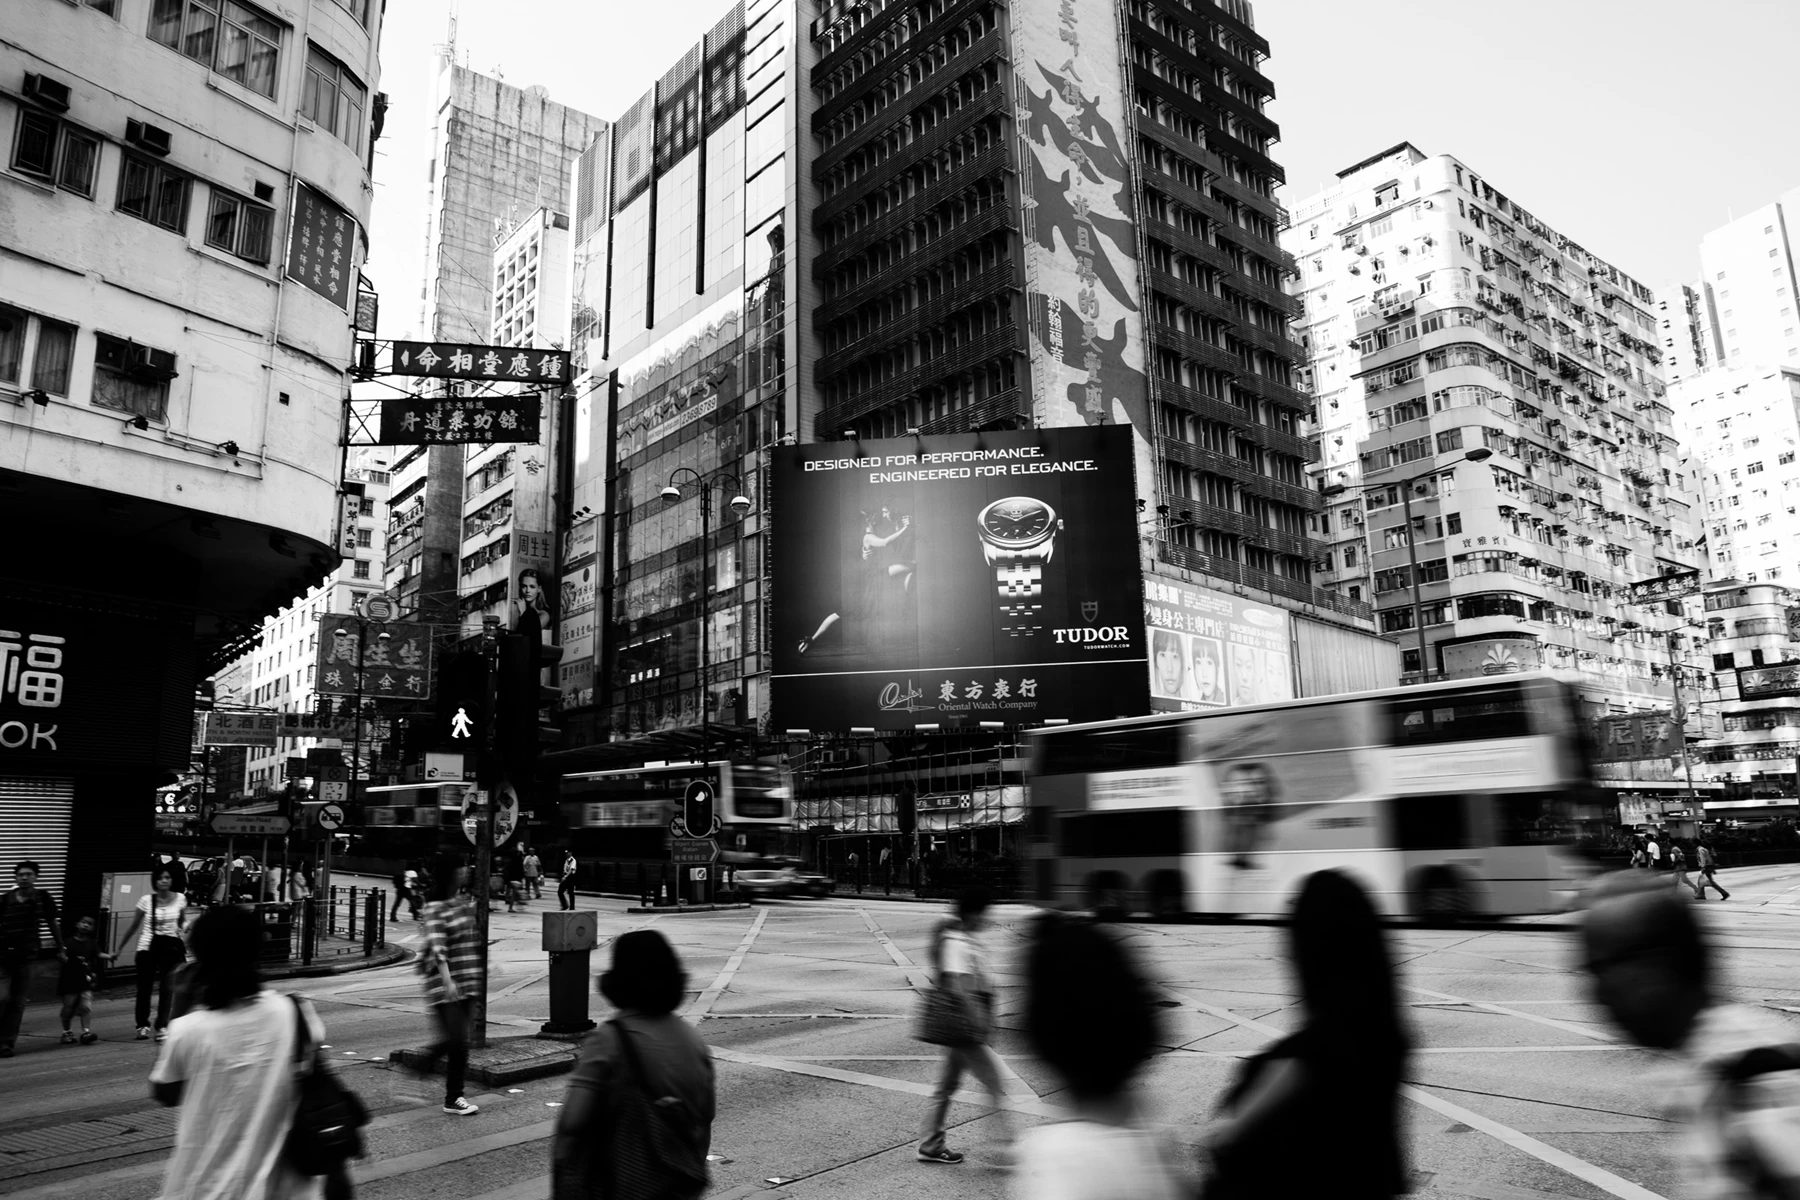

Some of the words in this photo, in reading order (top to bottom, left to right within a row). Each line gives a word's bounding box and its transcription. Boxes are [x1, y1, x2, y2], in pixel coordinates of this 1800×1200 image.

[804, 457, 881, 471] DESIGNED
[885, 454, 917, 466] FOR
[921, 447, 1044, 464] PERFORMANCE.
[869, 467, 971, 483] ENGINEERED
[975, 465, 1007, 477] FOR
[1011, 460, 1098, 474] ELEGANCE.
[517, 534, 550, 559] 周生生
[1053, 626, 1129, 643] TUDOR
[326, 634, 423, 670] 周生生
[0, 630, 66, 708] 福
[938, 678, 1038, 702] 東方表行
[938, 702, 971, 711] Oriental
[973, 701, 998, 710] Watch
[998, 700, 1038, 711] Company
[206, 715, 274, 730] 北酒店
